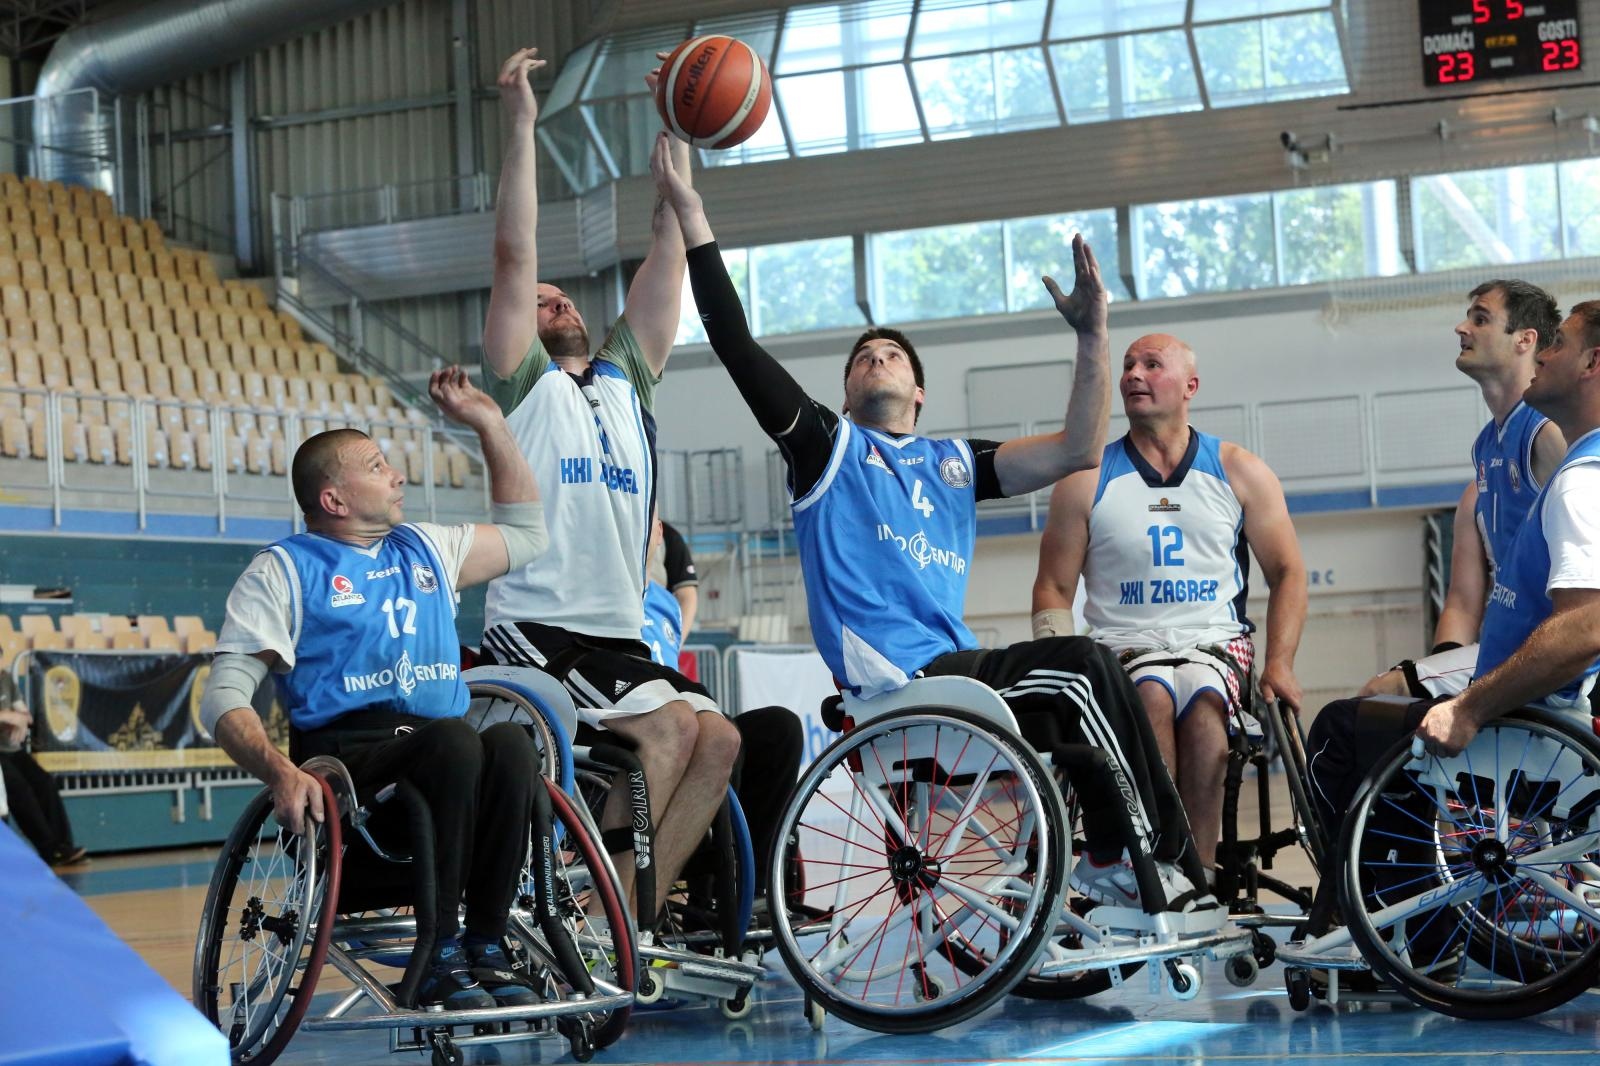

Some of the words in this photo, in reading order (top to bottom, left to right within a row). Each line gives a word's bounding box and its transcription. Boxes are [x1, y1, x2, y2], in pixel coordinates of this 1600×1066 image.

[1538, 19, 1577, 41] GOSTI
[1438, 52, 1475, 83] 23
[1542, 40, 1580, 71] 23
[681, 45, 717, 106] molten
[560, 457, 592, 484] KKI
[898, 457, 925, 466] eus
[911, 479, 935, 518] 4
[1147, 525, 1184, 566] 12
[366, 566, 400, 580] Zeus
[1119, 581, 1144, 604] KKI
[1150, 580, 1218, 603] ZAGREB
[381, 597, 417, 639] 12
